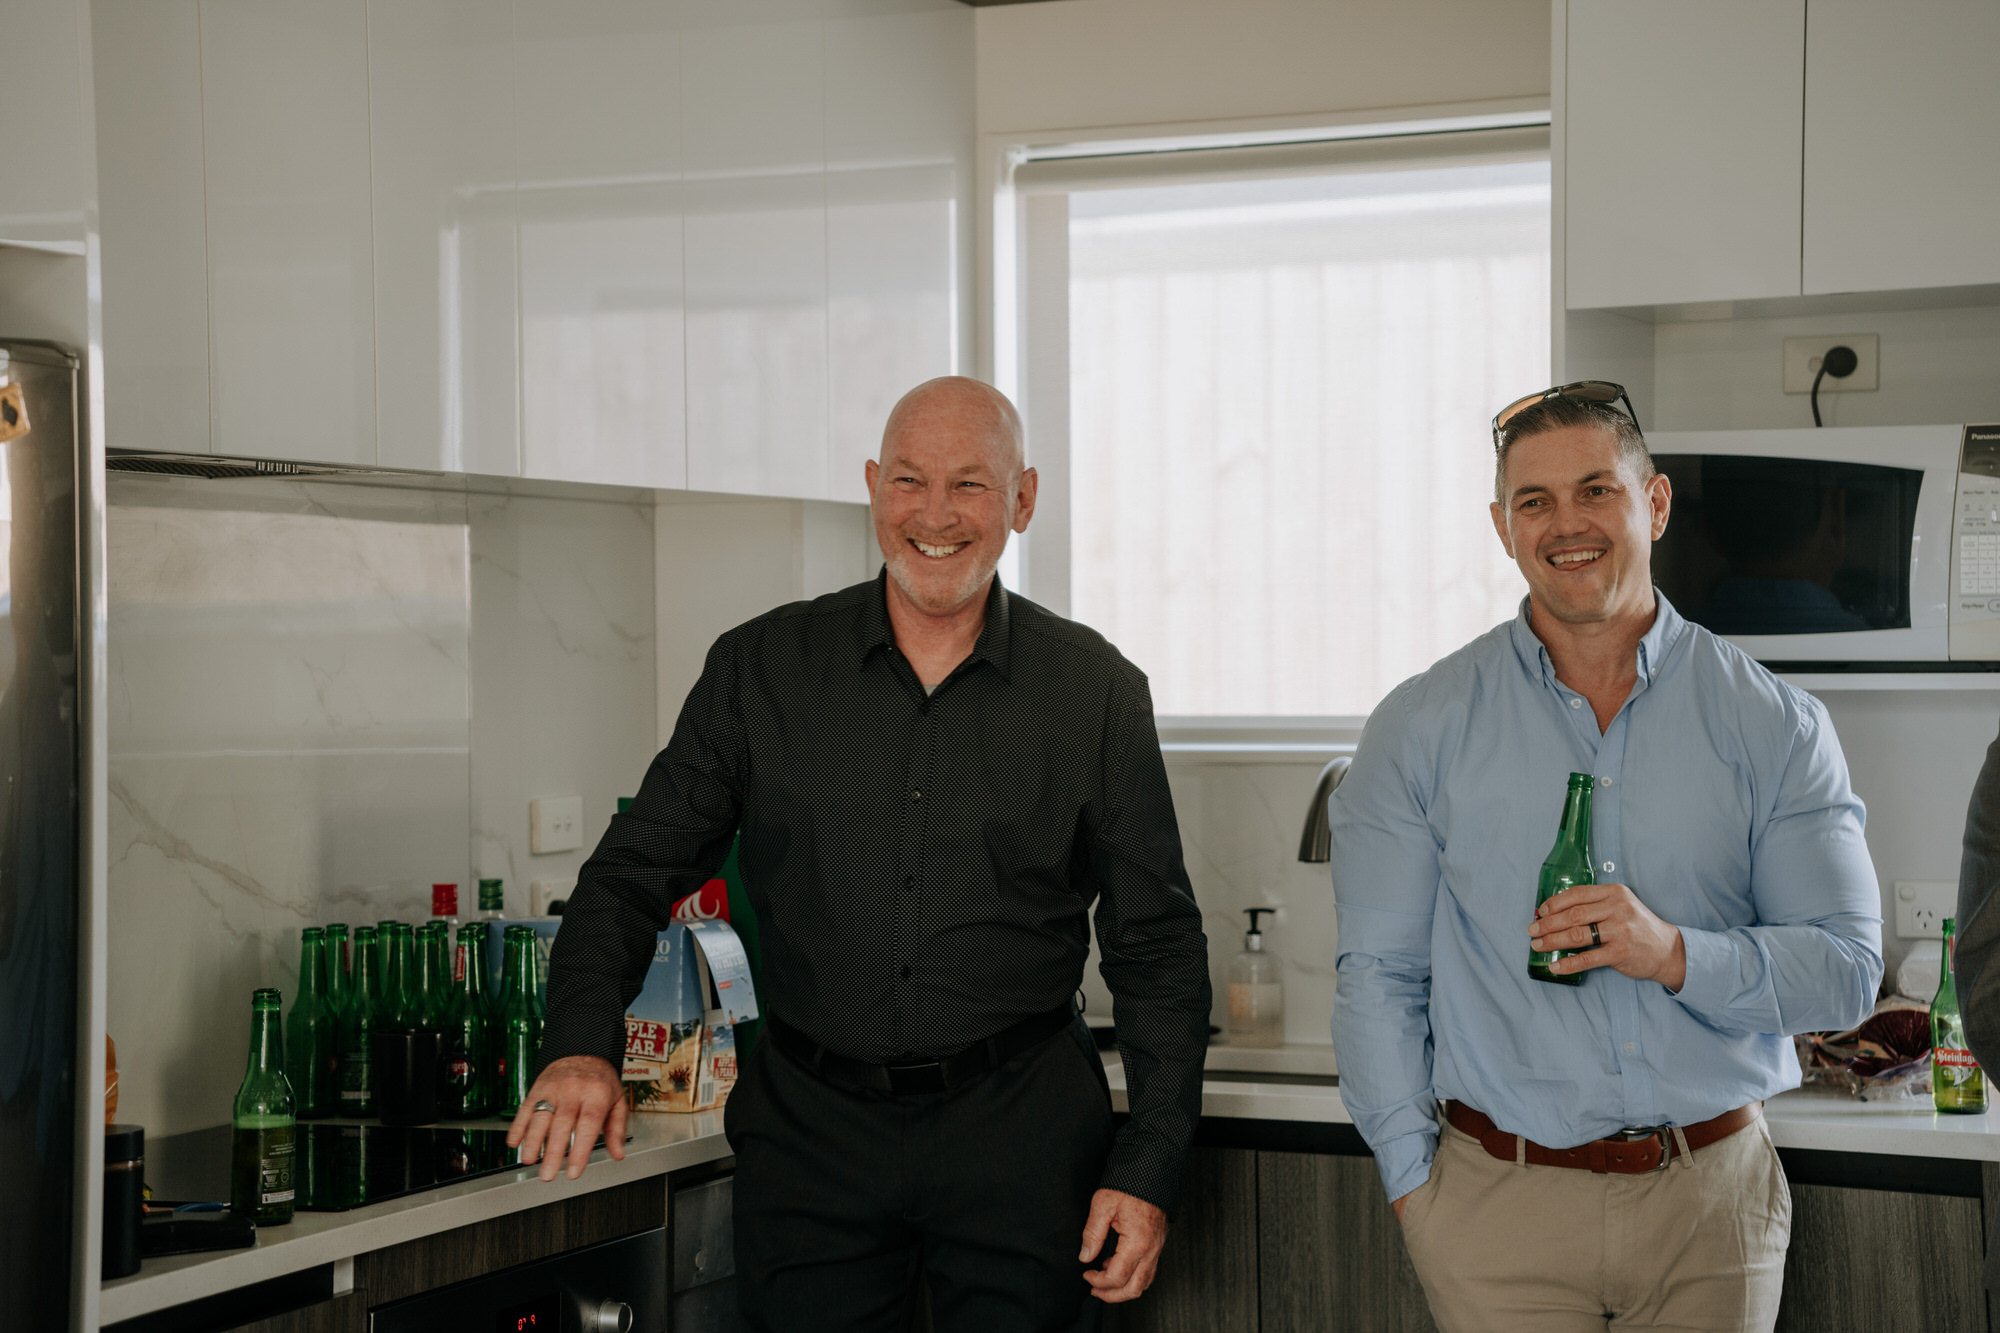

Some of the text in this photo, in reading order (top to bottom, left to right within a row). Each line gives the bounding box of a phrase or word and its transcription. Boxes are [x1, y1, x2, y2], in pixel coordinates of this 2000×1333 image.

[1971, 432, 2000, 440] Panaso
[625, 1022, 657, 1040] PLE
[625, 1038, 656, 1057] EAR
